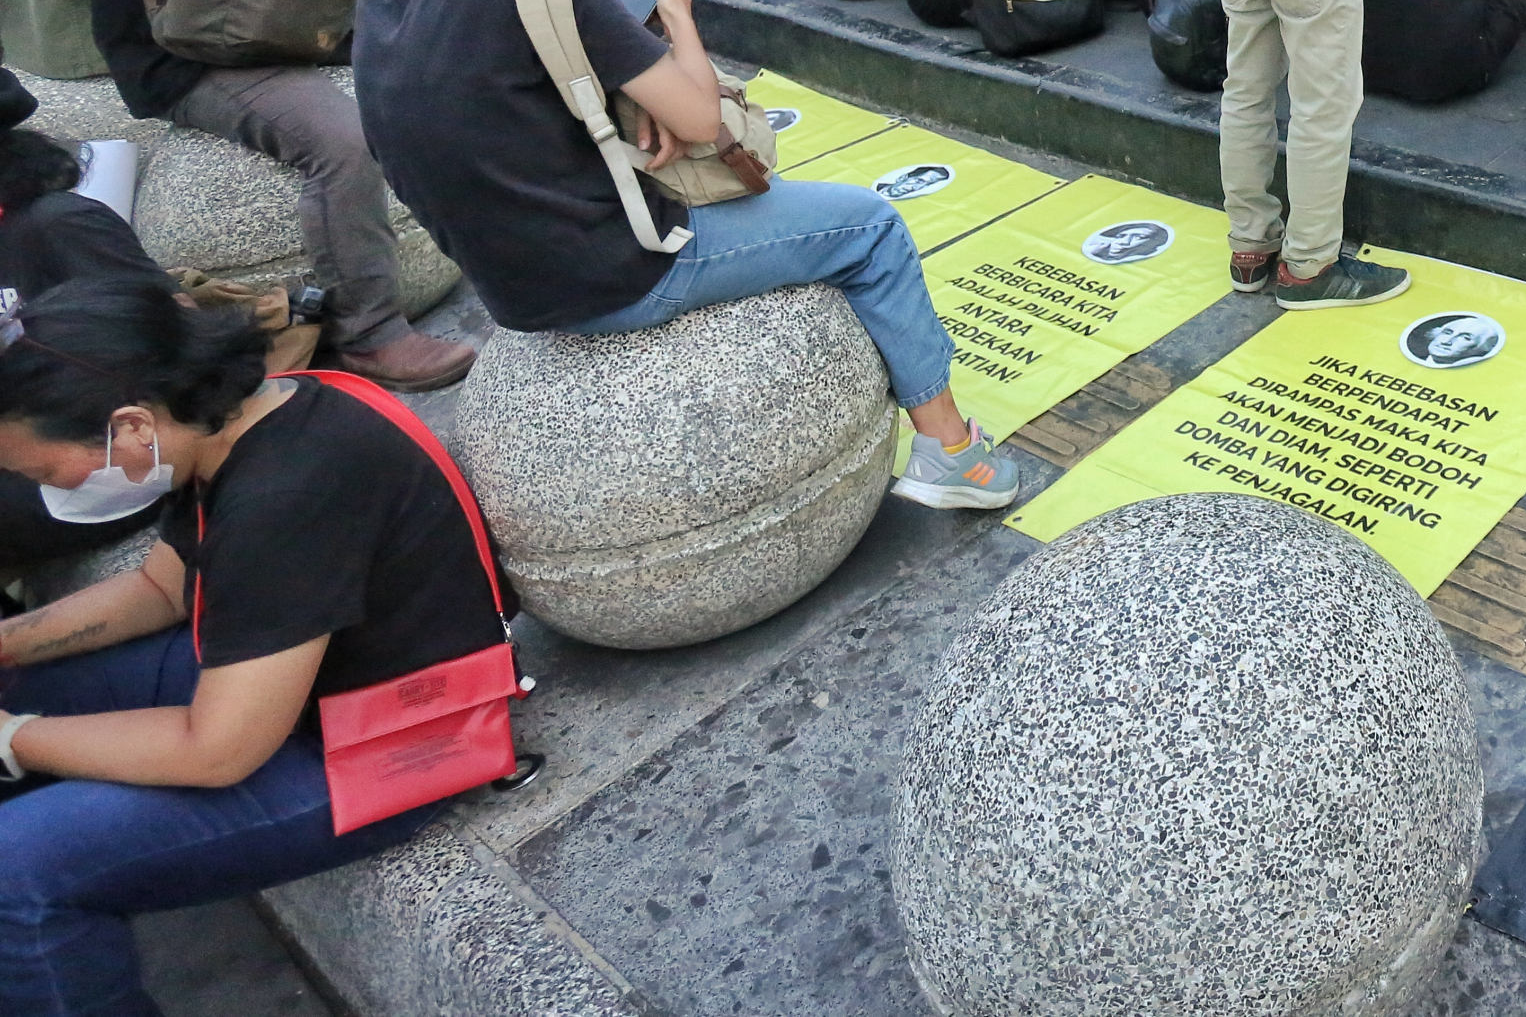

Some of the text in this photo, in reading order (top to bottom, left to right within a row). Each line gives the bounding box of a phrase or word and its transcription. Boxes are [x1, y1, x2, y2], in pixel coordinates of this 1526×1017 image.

[945, 277, 1101, 337] ADALAH PILIHAN
[973, 263, 1119, 323] BERBICARA KITA
[1013, 256, 1126, 301] KEBEBASAN
[954, 302, 1033, 337] ANTARA
[952, 348, 1023, 384] ATIAN!
[1309, 355, 1499, 422] JIKA KEBEBASAN
[1247, 377, 1488, 467] DIRAMPAS MAKA KITA
[1303, 373, 1469, 434] BERPENDAPAT
[1217, 411, 1439, 499] DAN DIAM, SEPERTI
[1218, 390, 1483, 490] AKAN MENJADI BODOH
[1174, 420, 1442, 529] DOMBA YANG DIGIRING
[1183, 451, 1380, 535] KE PENJAGALAN.
